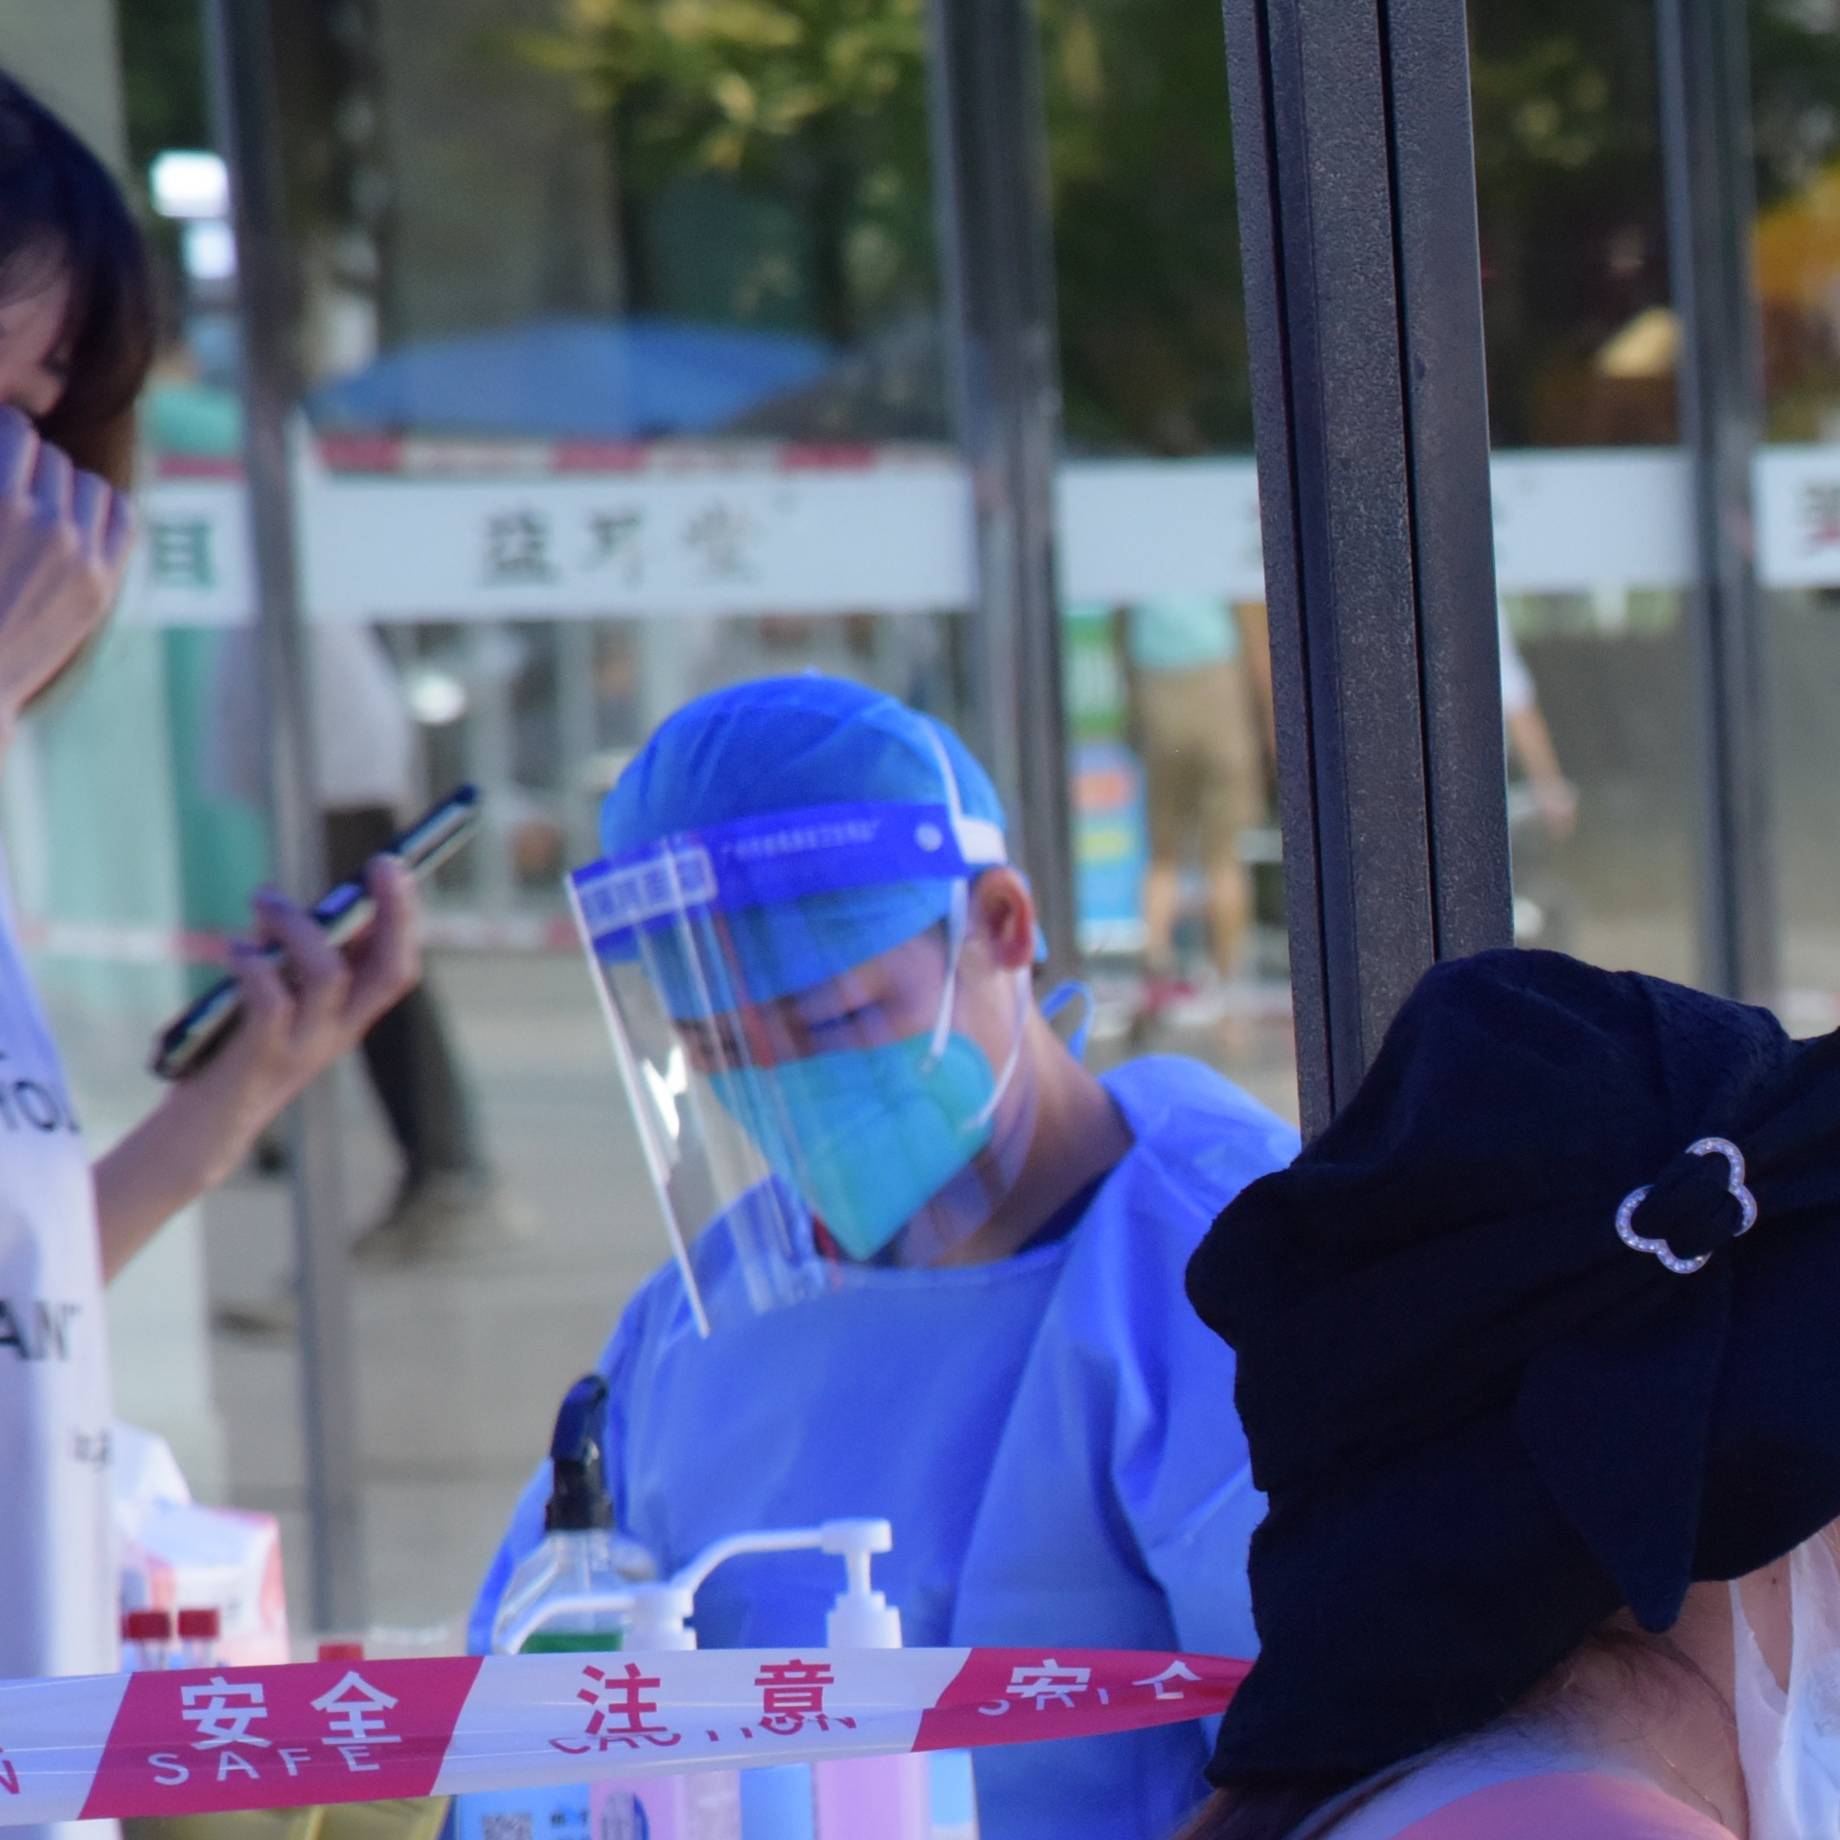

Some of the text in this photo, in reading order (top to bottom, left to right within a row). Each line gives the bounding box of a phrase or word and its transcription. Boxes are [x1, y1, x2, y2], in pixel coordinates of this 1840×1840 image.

[180, 1670, 402, 1750] 安全
[577, 1657, 834, 1736] 注意
[147, 1745, 381, 1786] SAFE
